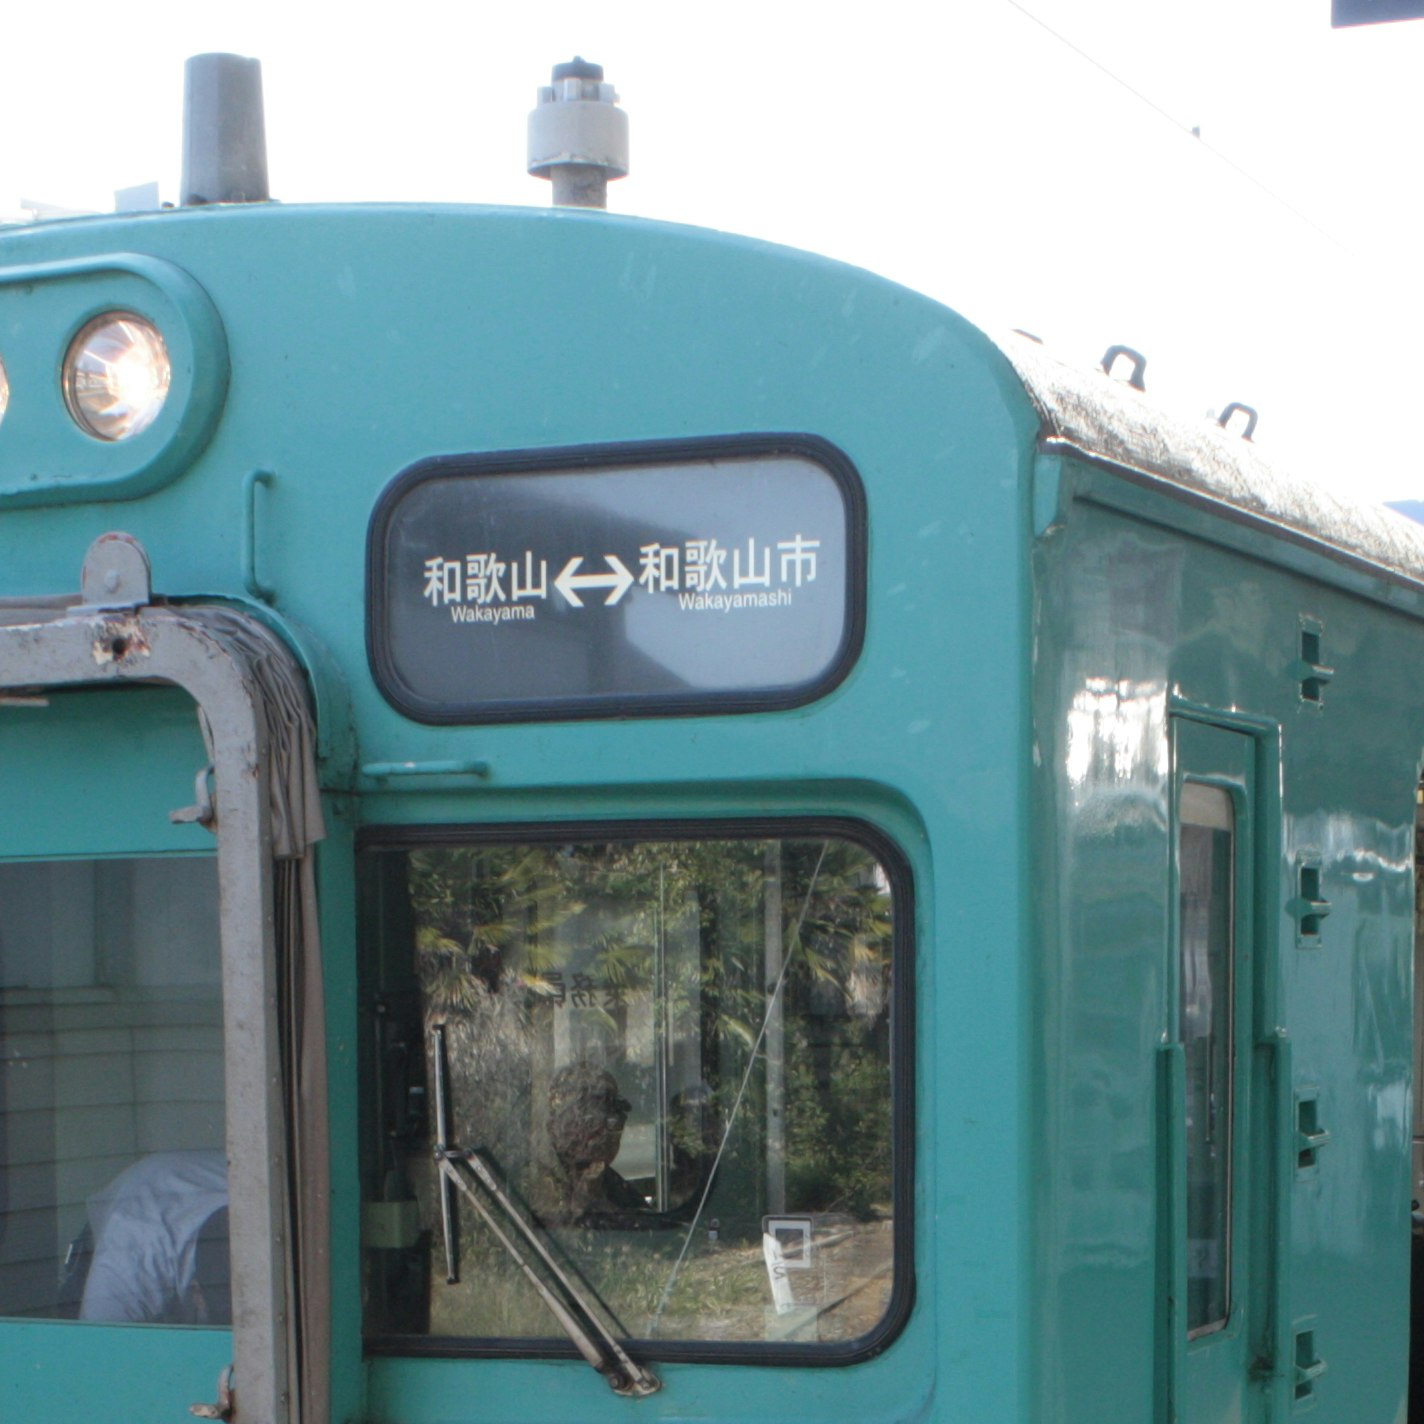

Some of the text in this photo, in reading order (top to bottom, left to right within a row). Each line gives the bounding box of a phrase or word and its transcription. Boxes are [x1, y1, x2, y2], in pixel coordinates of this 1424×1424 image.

[423, 533, 821, 606] 和歌山 和歌山市
[451, 588, 793, 625] Wakayama Wakayamashi
